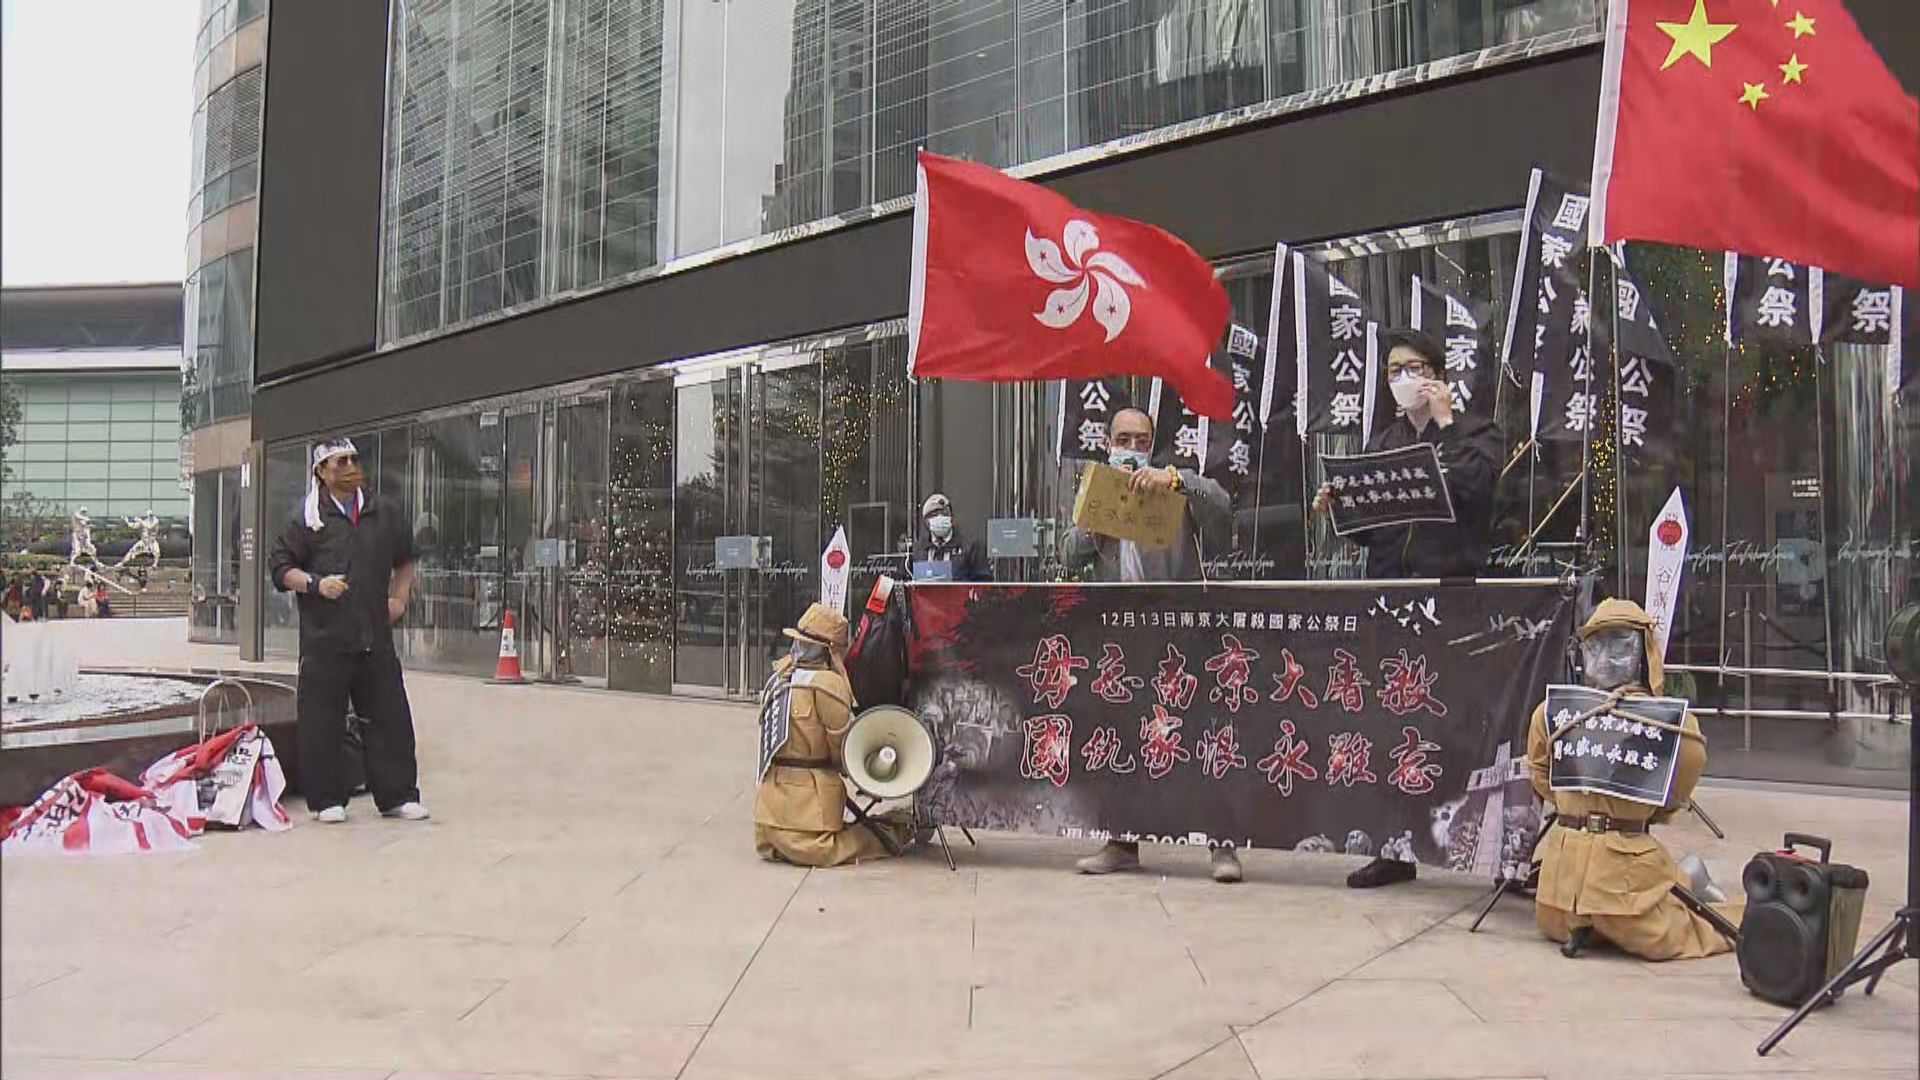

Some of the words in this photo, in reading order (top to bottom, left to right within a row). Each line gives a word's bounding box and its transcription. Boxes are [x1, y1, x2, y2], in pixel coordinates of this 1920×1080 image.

[1851, 287, 1891, 333] 祭
[1078, 380, 1110, 451] 公祭
[1101, 612, 1358, 632] 12月13日南京大屠殺國家公祭日
